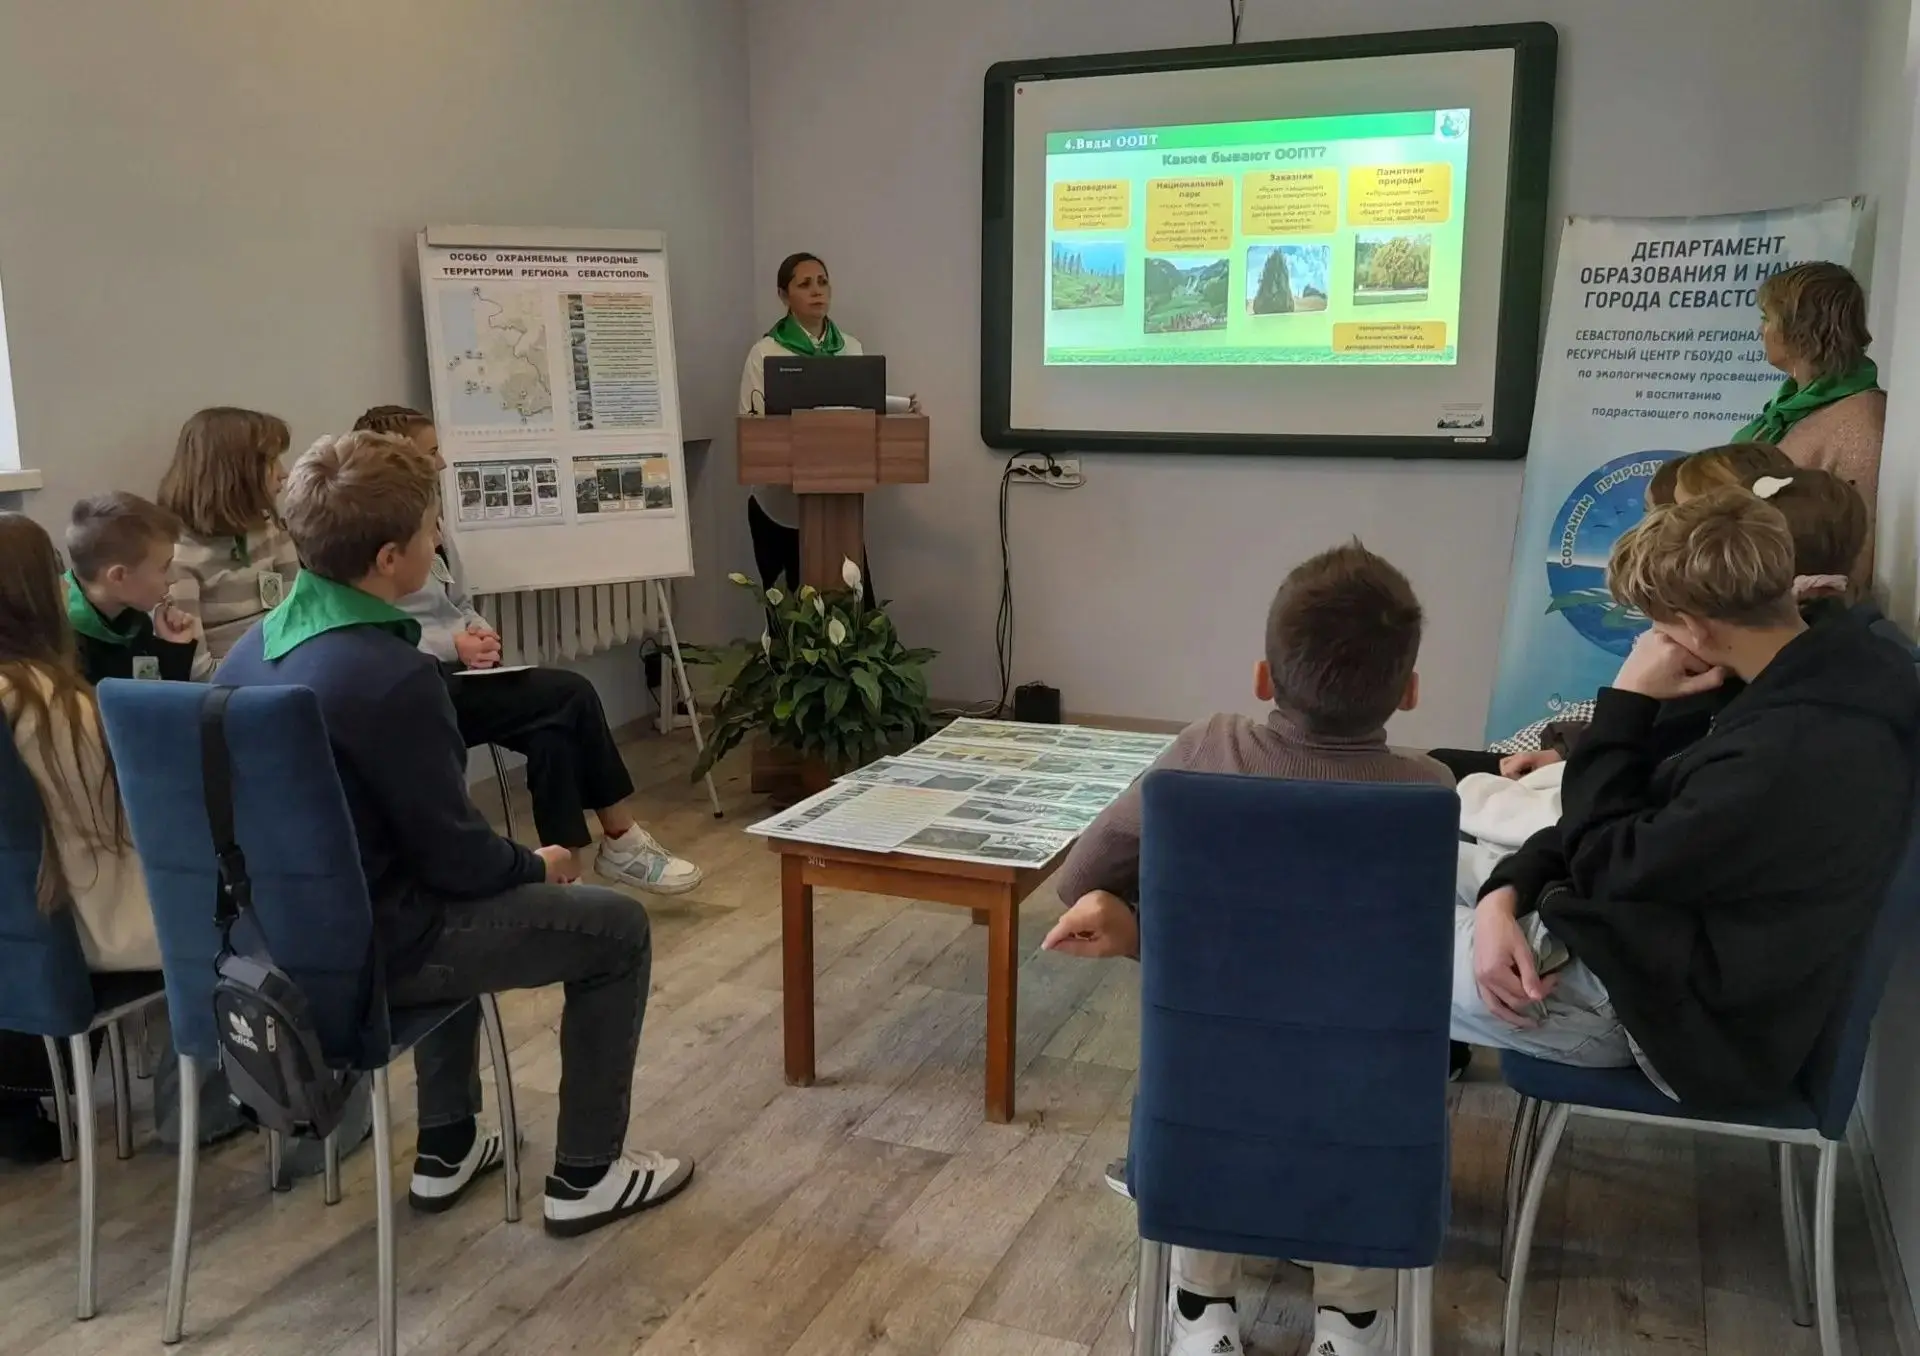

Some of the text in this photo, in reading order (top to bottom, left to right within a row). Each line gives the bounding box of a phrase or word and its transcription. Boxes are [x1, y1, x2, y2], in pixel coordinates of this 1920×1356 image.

[1064, 134, 1159, 151] 4.Виды ООПТ
[1162, 146, 1327, 166] Какие бывают ООПТ?
[1269, 172, 1314, 182] Заказник
[1378, 177, 1422, 187] природы
[1156, 179, 1225, 191] Национальный
[1178, 191, 1201, 200] парк
[1631, 236, 1785, 262] ДЕПАРТАМЕНТ
[449, 252, 639, 265] ОСОБО ОХРАНЯЕМЫЕ ПРИРОДНЫЕ
[442, 267, 649, 279] ТЕРРИТОРИИ РЕГИОНА СЕВАСТОПОЛЬ
[1580, 264, 1727, 285] ОБРАЗОВАНИЯ
[1734, 263, 1749, 282] И
[1584, 289, 1756, 312] ГОРОДА СЕВАСТО
[1575, 328, 1765, 342] СЕВАСТОПОЛЬСКИЙ РЕГИОНАЛ
[1566, 347, 1636, 360] РЕСУРСНЫЙ
[1640, 349, 1681, 362] ЦЕНТР
[1684, 350, 1733, 363] ГБОУДО
[1578, 369, 1592, 379] по
[1596, 370, 1697, 384] экологическому
[1635, 390, 1722, 401] и воспитанию
[1592, 407, 1690, 420] подрастающего
[1561, 495, 1594, 567] СОХРАНИМ
